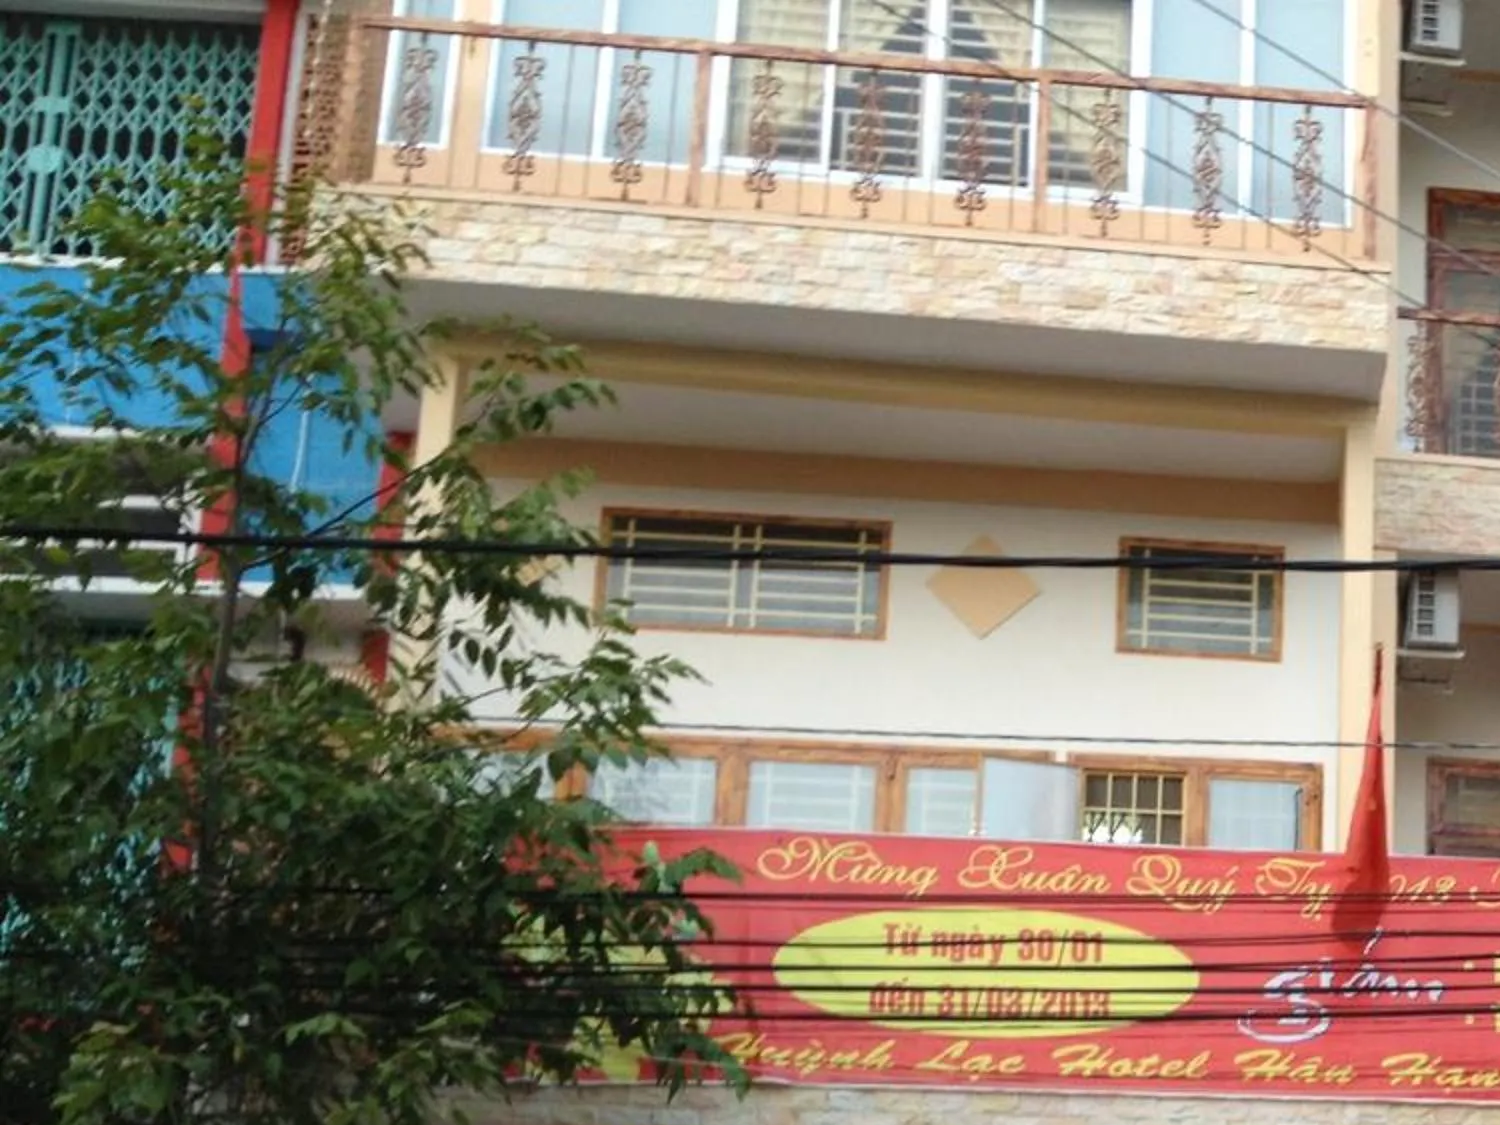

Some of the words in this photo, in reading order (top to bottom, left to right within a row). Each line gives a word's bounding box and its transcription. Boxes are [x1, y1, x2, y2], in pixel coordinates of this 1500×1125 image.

[757, 837, 938, 896] Mừng
[958, 844, 1112, 894] Xuân
[1125, 853, 1240, 914] Quý
[884, 923, 923, 957] Từ
[930, 926, 1005, 967] ngày
[1018, 927, 1104, 966] 30/01
[914, 1039, 1027, 1081] Lạc
[1052, 1043, 1212, 1079] Hotel
[1234, 1049, 1356, 1083] Hân
